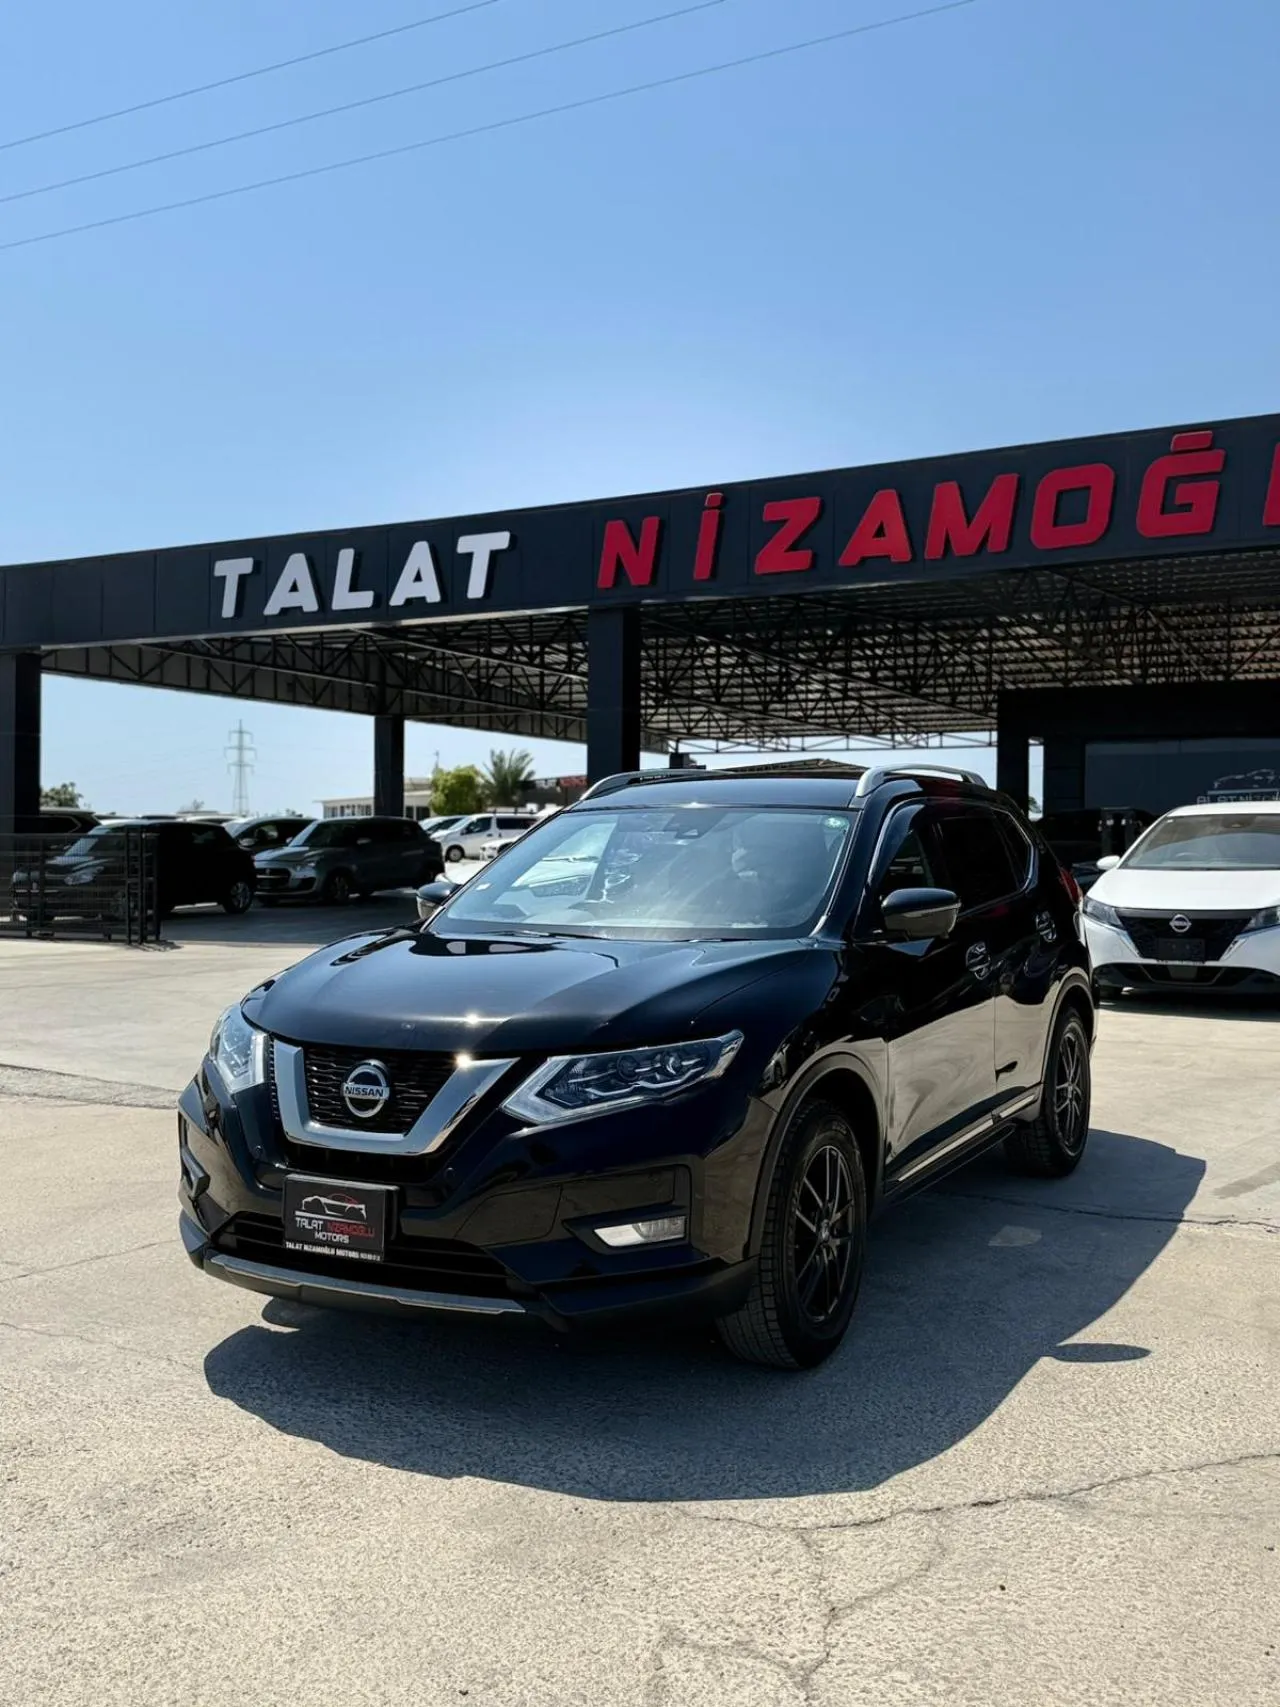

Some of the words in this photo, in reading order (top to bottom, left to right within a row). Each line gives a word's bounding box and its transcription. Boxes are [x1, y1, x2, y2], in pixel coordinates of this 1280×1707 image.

[213, 531, 510, 619] TALAT
[597, 431, 1280, 588] NİZAMOĞ
[345, 1086, 384, 1097] NISSAN
[295, 1217, 323, 1230] TALAT
[315, 1232, 349, 1243] MOTORS
